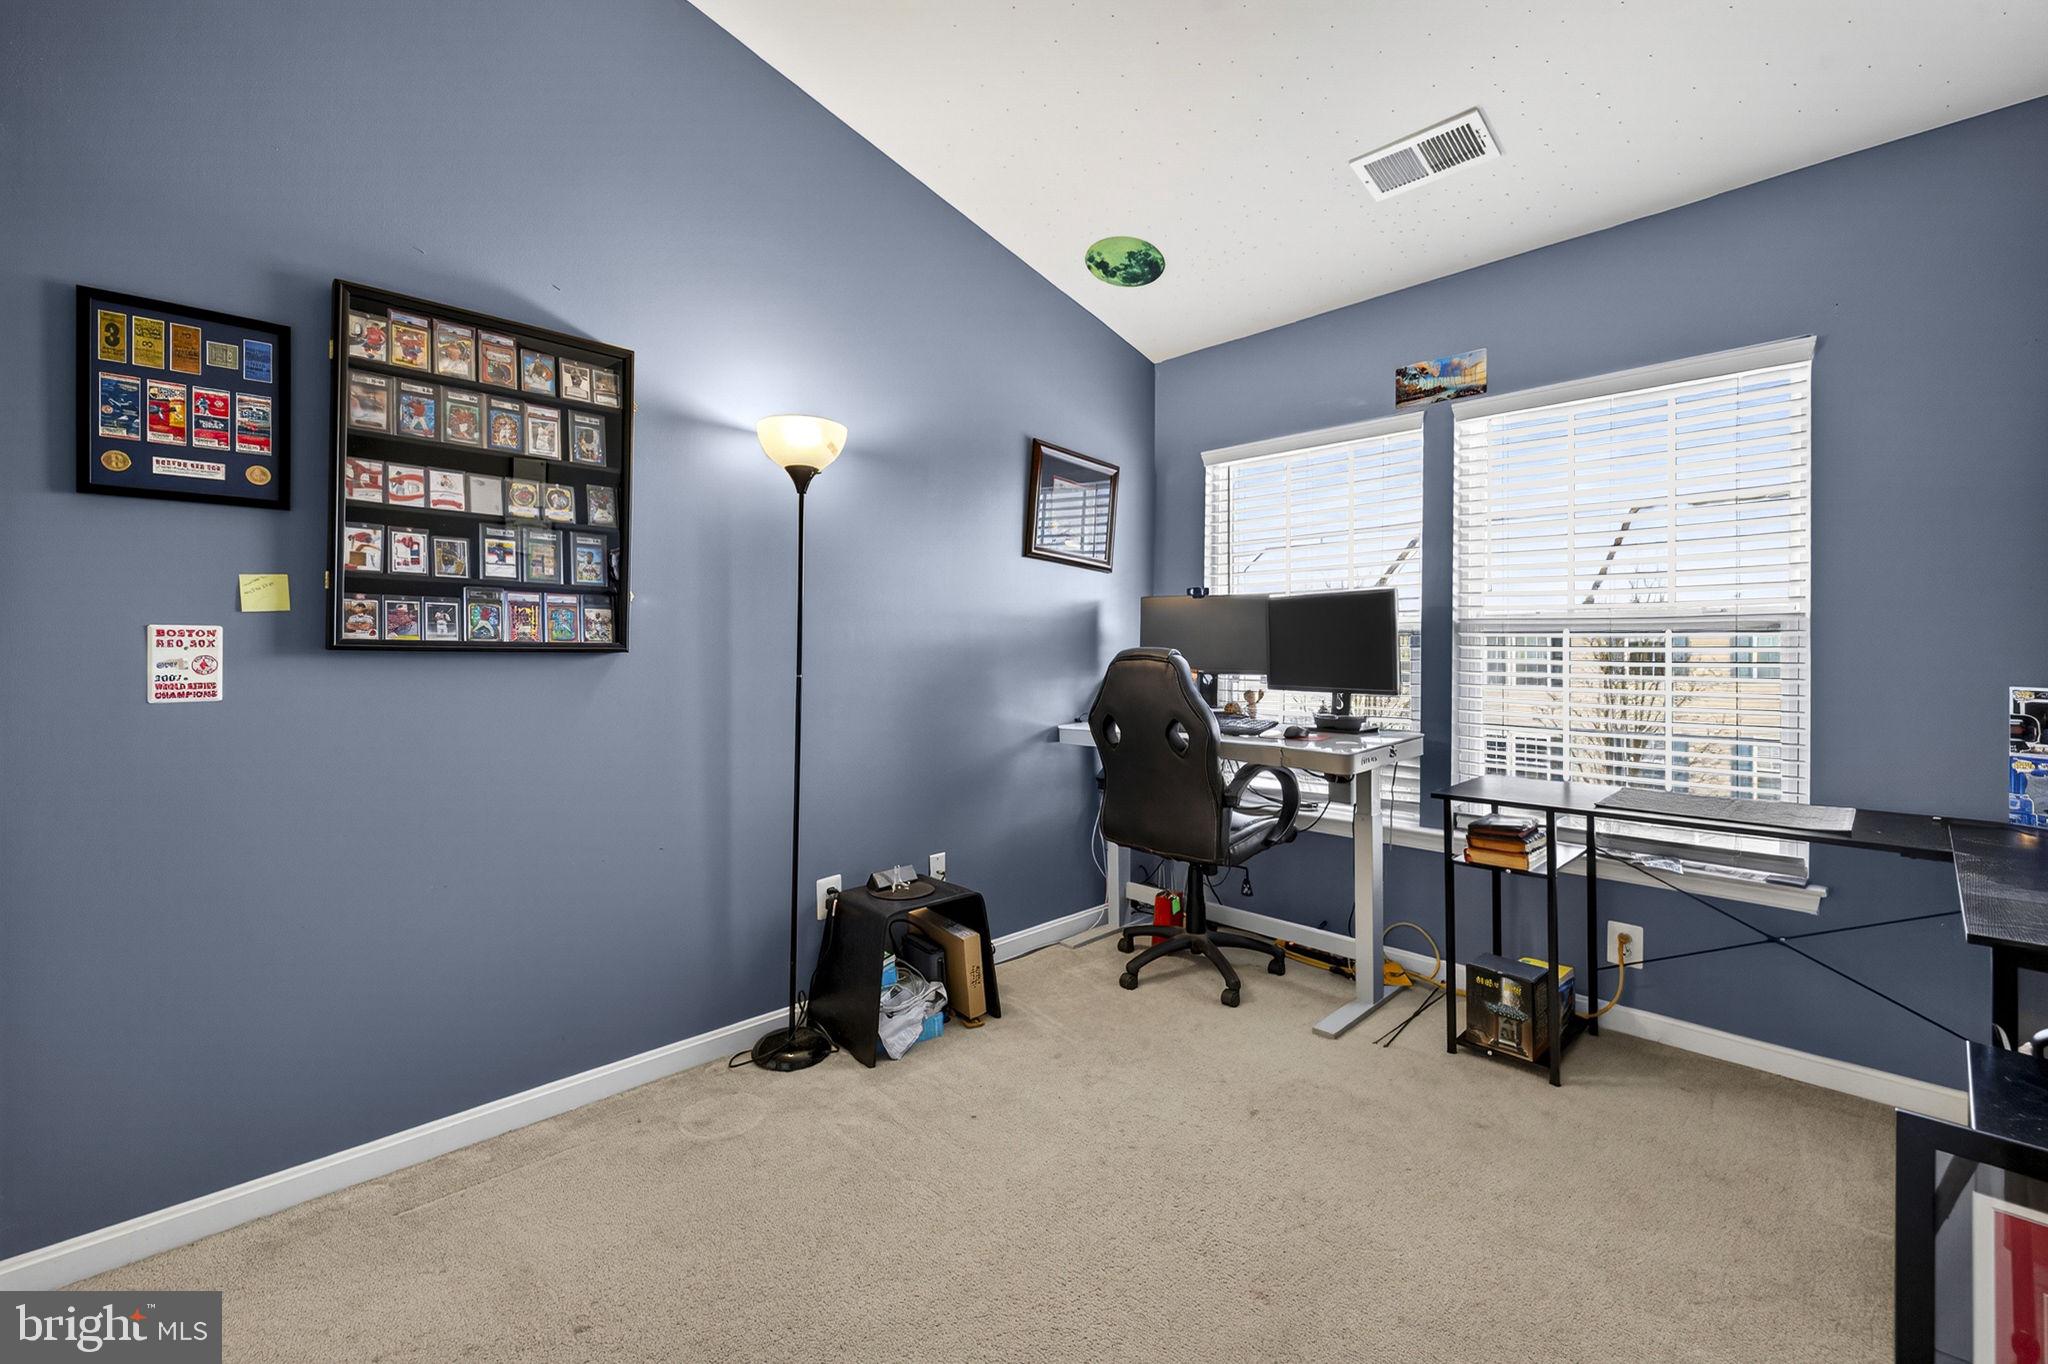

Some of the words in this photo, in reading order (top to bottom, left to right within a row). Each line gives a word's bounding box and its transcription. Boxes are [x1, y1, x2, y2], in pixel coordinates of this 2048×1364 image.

[155, 629, 217, 637] BOSTON
[156, 639, 184, 648] RED
[190, 639, 216, 648] SOX
[154, 683, 186, 691] WORLD
[187, 682, 217, 690] SERIES
[154, 691, 218, 700] CHAMPIONS
